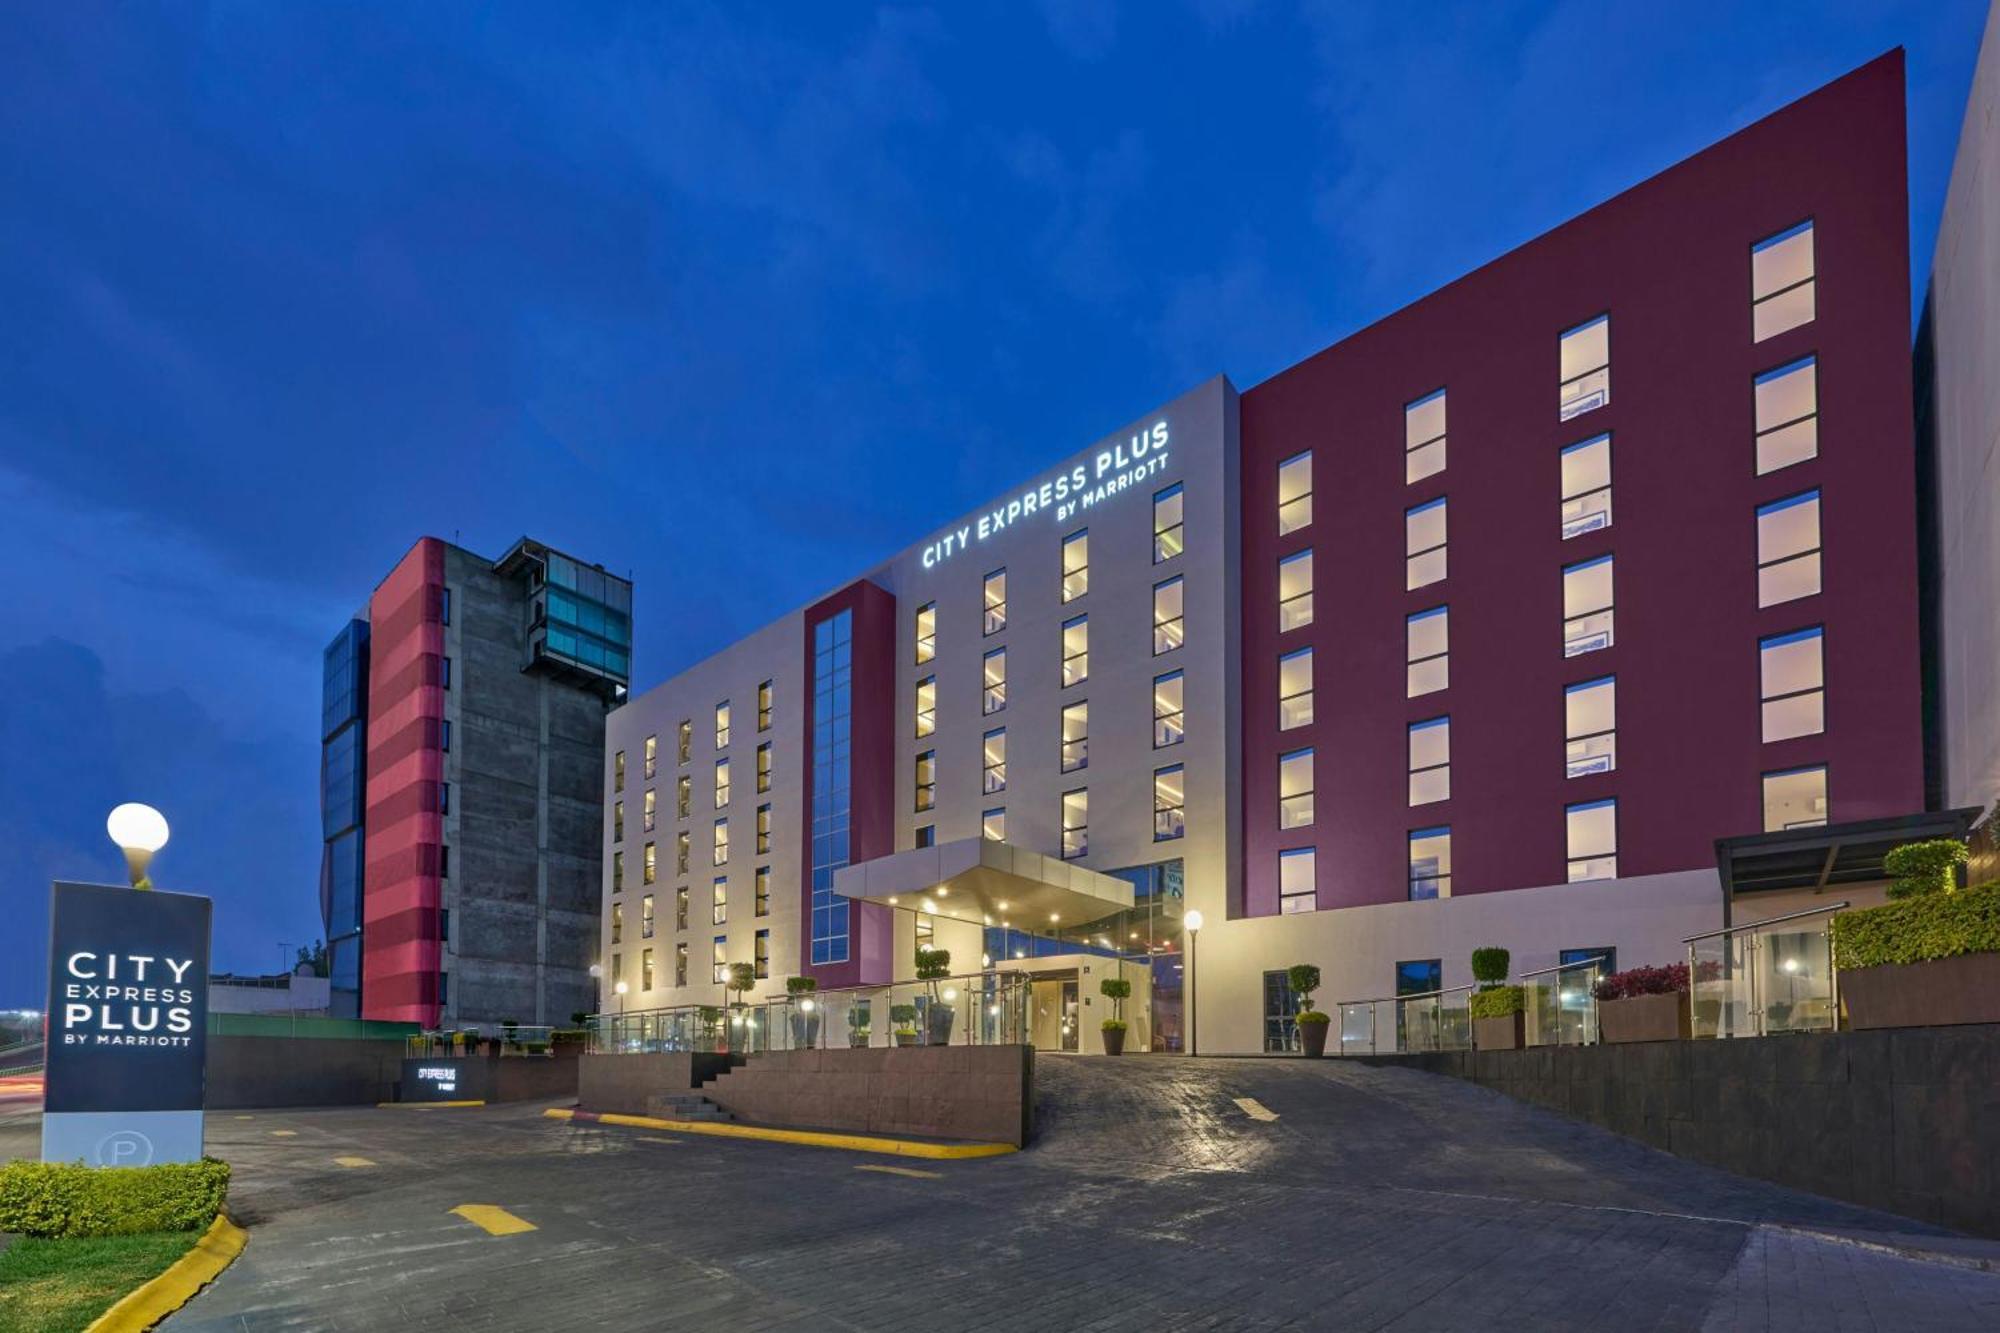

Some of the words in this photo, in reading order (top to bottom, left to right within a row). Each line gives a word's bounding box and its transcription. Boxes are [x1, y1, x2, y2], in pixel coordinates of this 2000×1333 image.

[922, 526, 970, 568] CITY
[977, 466, 1086, 539] EXPRESS
[1096, 421, 1169, 479] PLUS
[1057, 500, 1077, 521] BY
[1082, 453, 1169, 509] MARRIOTT
[68, 952, 193, 983] CITY
[66, 984, 193, 1004] EXPRESS
[65, 1003, 192, 1033] PLUS
[64, 1034, 88, 1045] BY
[96, 1034, 191, 1047] MARRIOTT
[111, 1140, 137, 1165] P
